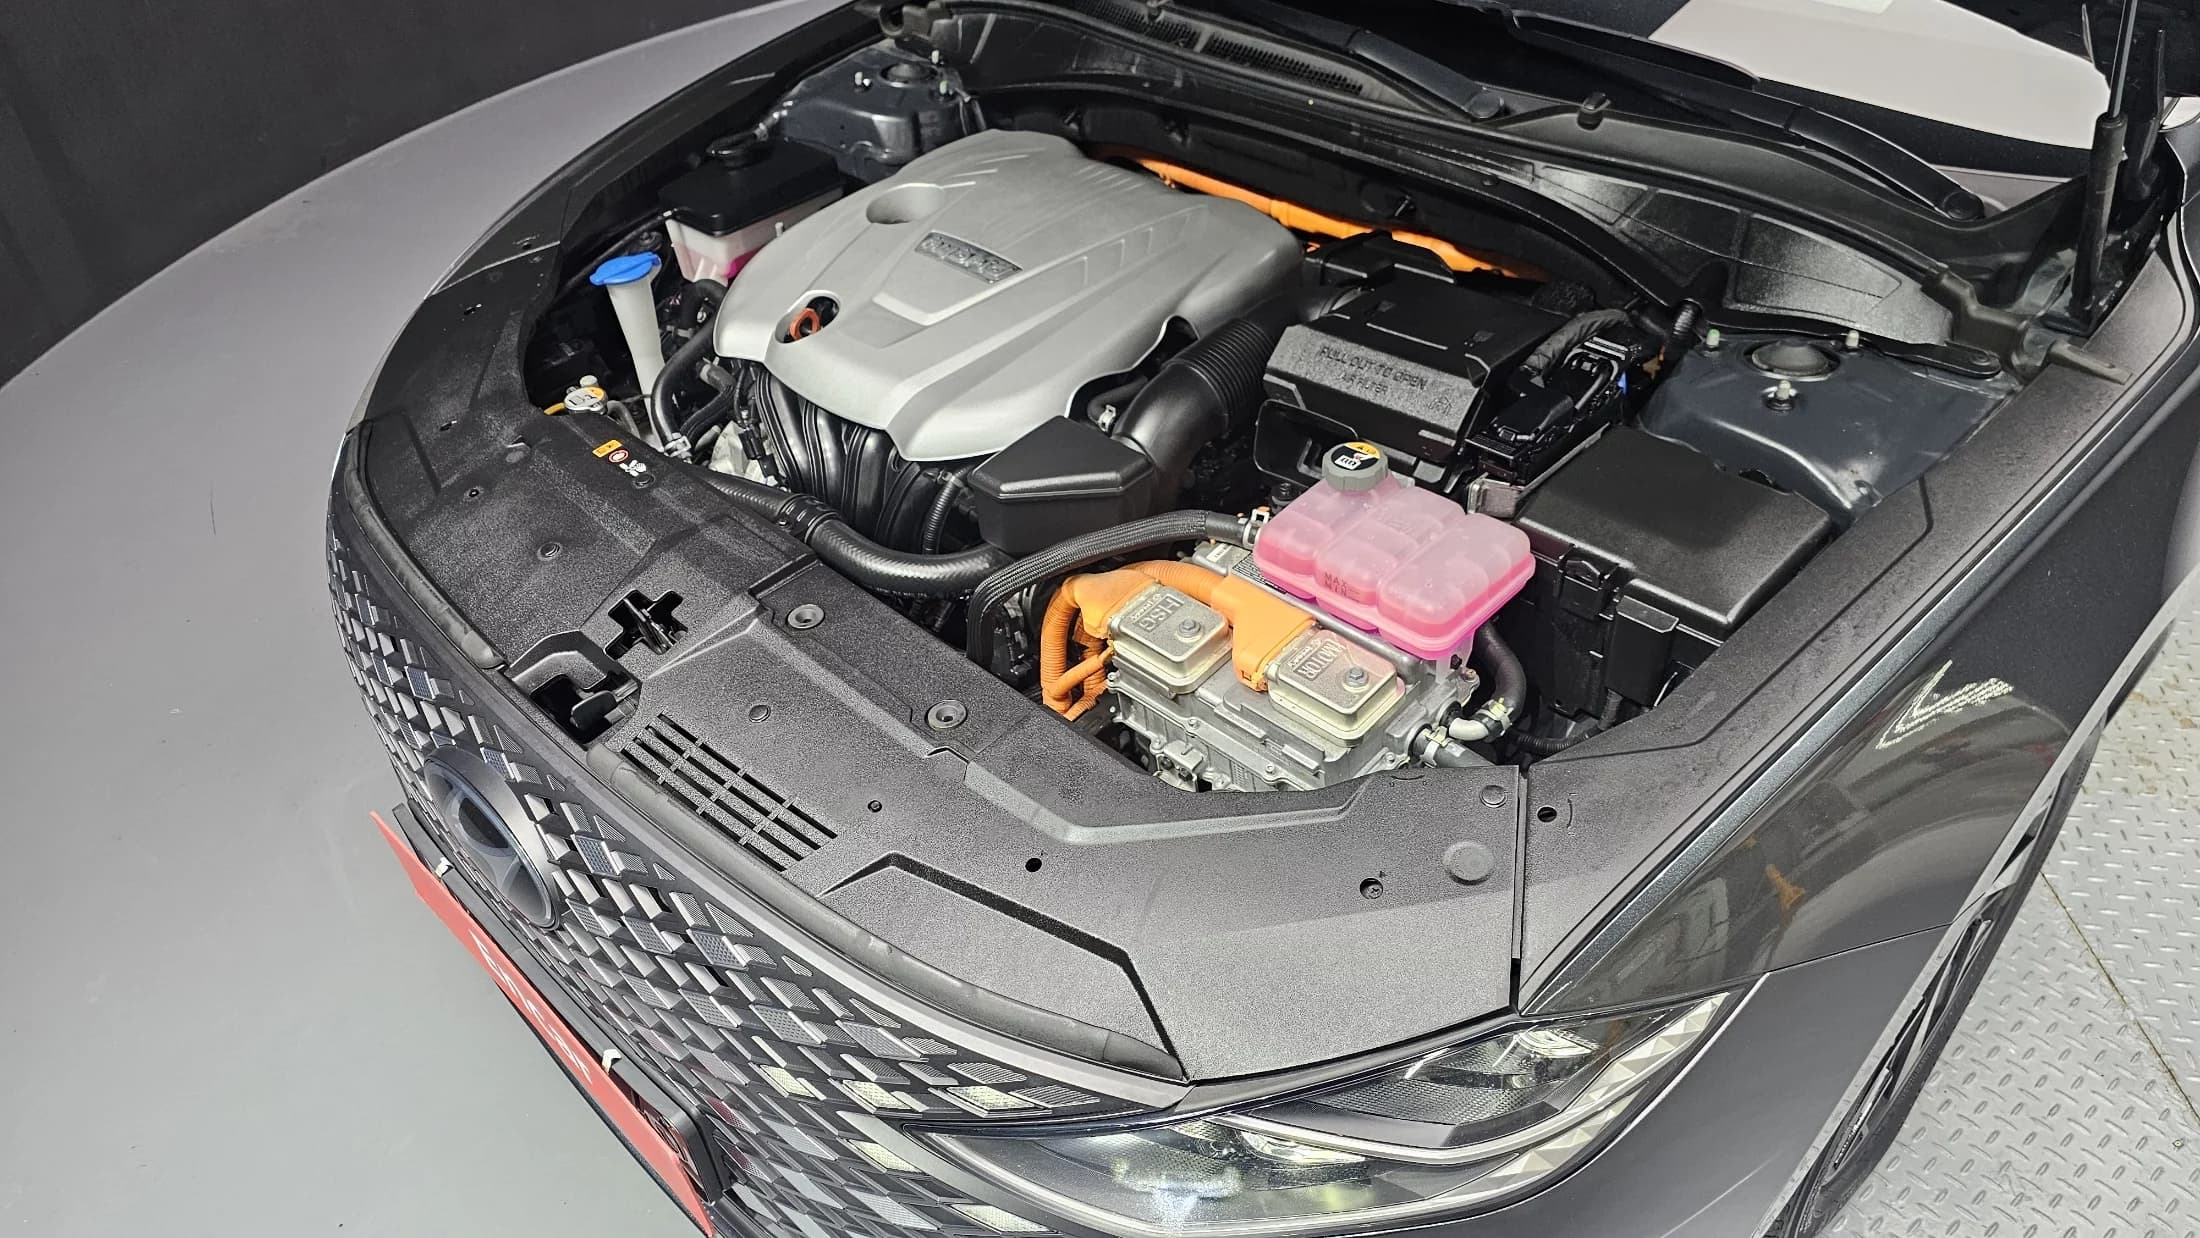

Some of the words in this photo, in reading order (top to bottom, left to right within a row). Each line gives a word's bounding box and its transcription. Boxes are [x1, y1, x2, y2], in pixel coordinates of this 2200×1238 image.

[1349, 356, 1376, 370] OUT
[1378, 364, 1394, 378] TO
[1393, 370, 1428, 390] OPEN
[1324, 571, 1348, 587] MAX
[1138, 597, 1181, 631] HSG
[1297, 641, 1342, 679] MOTOR
